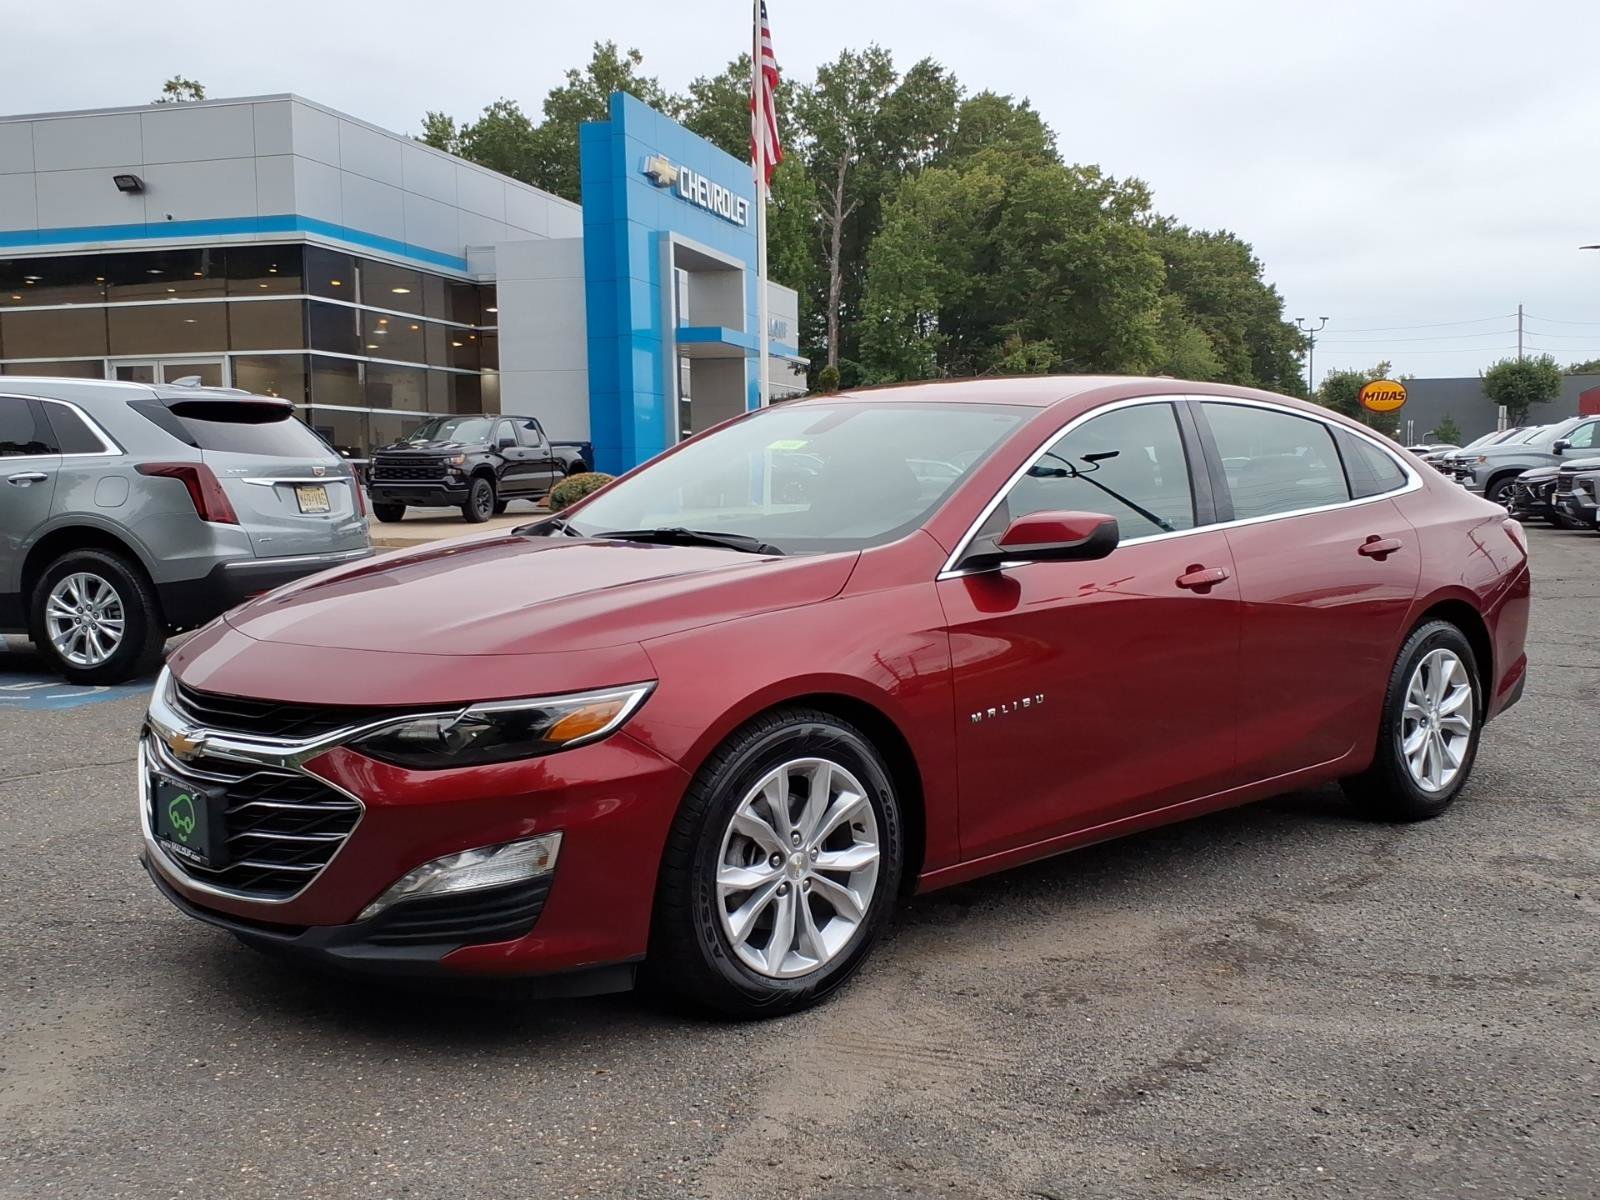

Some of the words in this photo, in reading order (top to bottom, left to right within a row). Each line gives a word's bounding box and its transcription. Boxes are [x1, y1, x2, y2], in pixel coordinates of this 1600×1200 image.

[680, 165, 749, 227] CHEVROLET
[1363, 391, 1405, 402] MIDAS
[971, 694, 1044, 723] MALIBU
